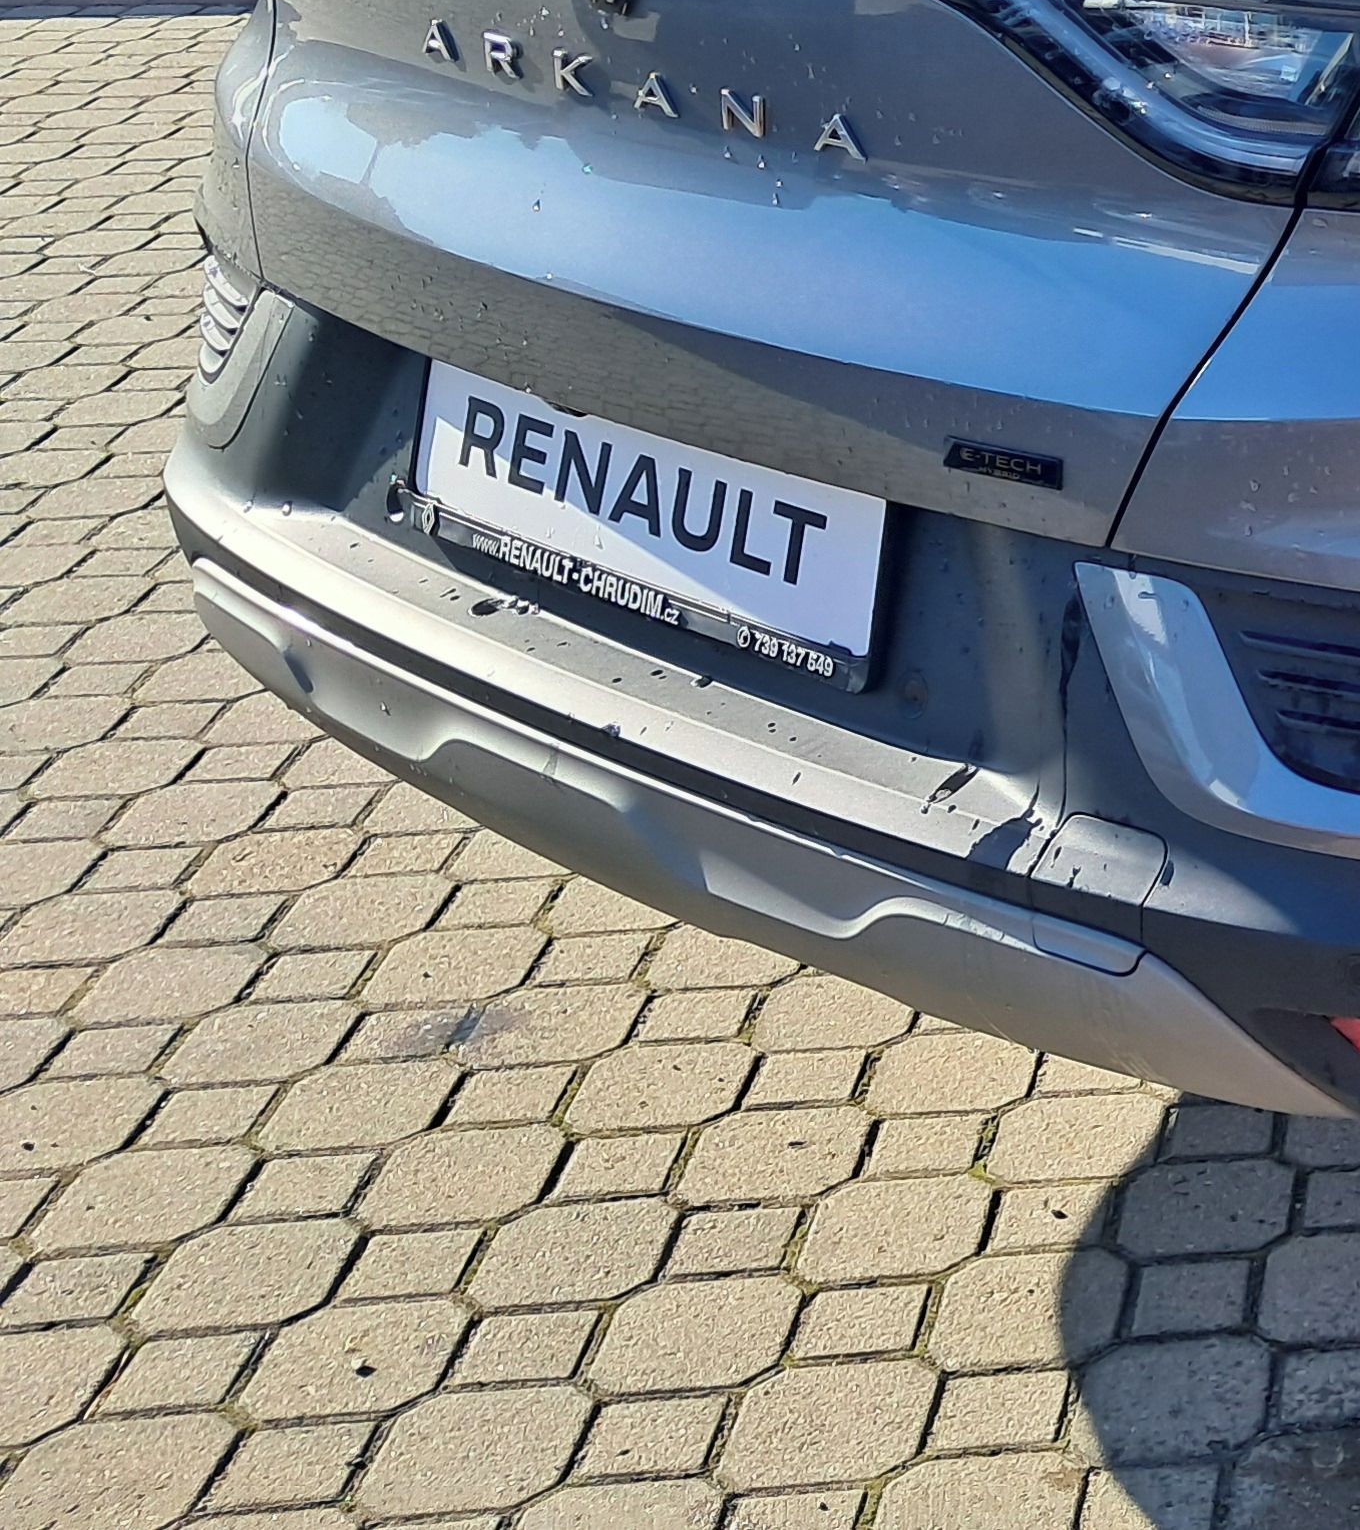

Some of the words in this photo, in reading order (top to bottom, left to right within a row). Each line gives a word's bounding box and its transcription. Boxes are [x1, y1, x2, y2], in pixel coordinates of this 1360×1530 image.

[422, 18, 867, 163] ARKANA
[458, 395, 828, 585] RENAULT
[960, 447, 1042, 475] E-TECH
[753, 631, 779, 658] 739
[781, 639, 806, 666] 137
